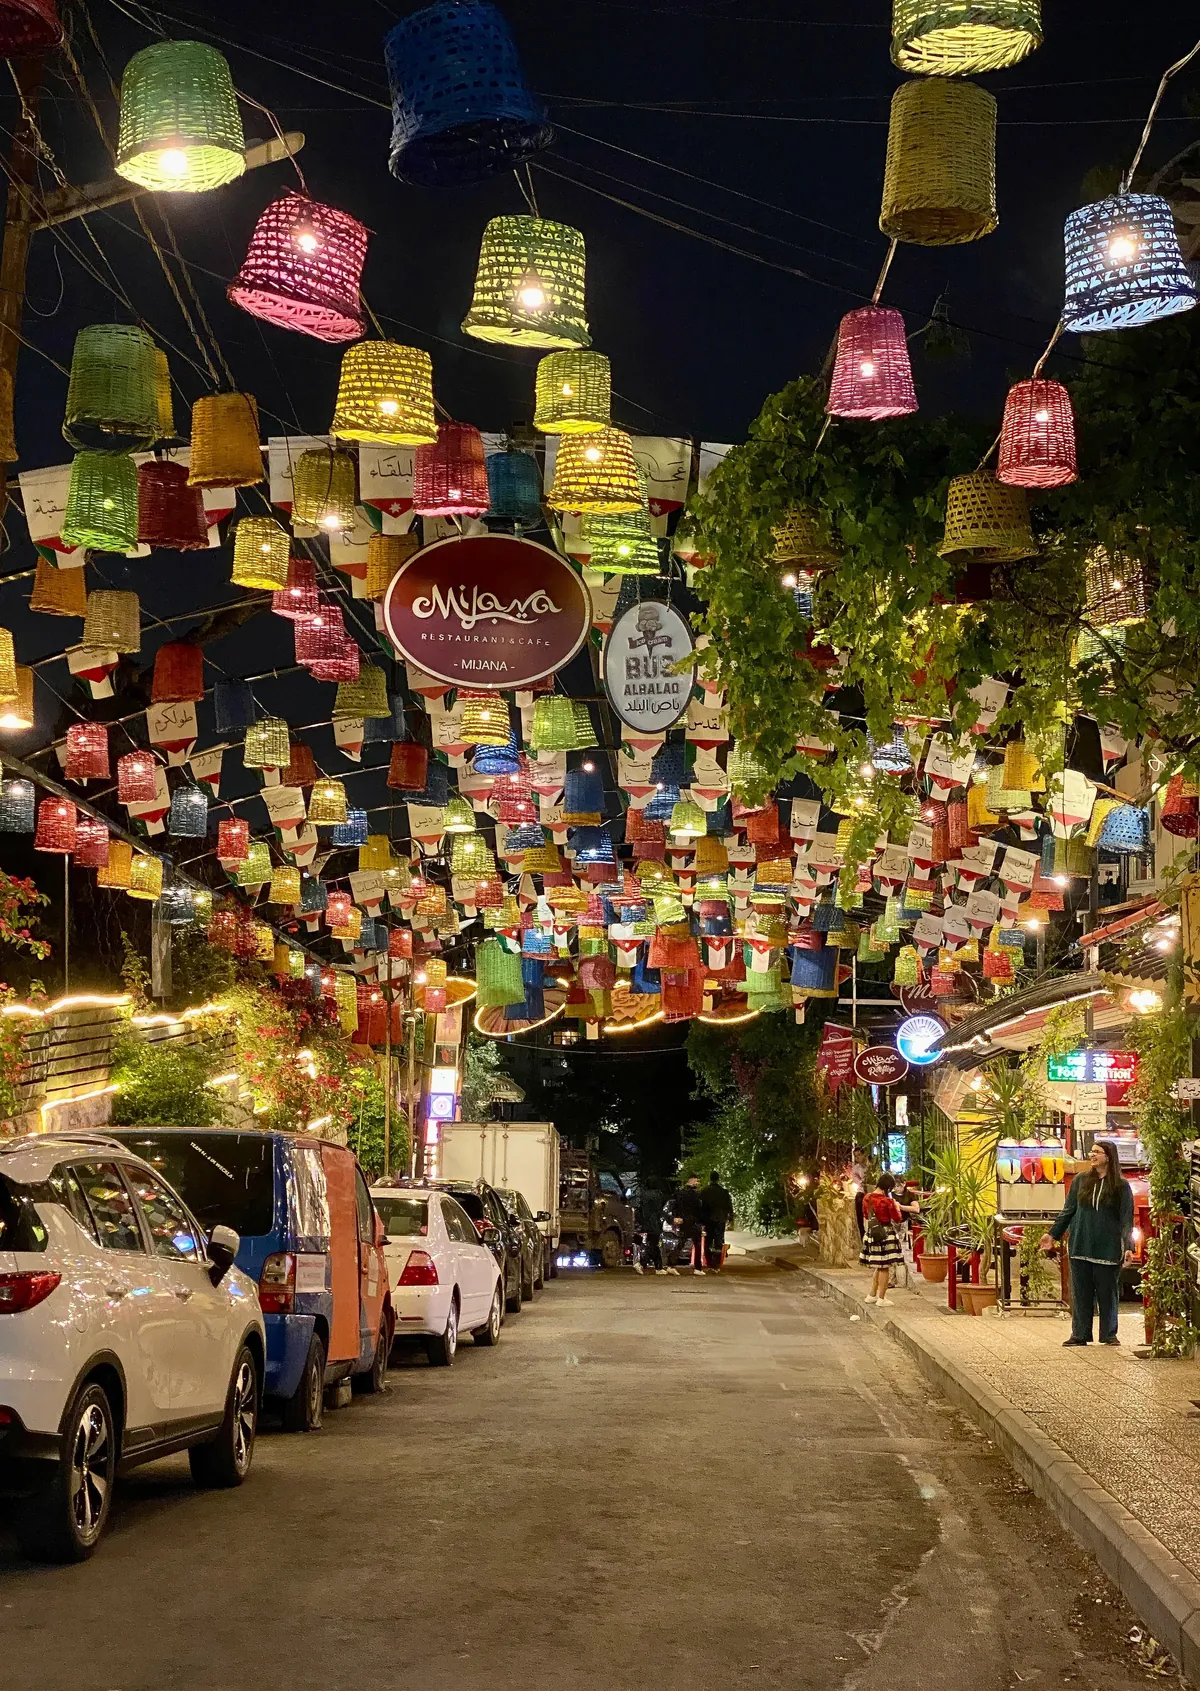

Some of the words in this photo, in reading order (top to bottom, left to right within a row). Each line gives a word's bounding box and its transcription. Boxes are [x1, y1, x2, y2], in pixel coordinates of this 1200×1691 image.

[412, 584, 563, 630] Mijana
[461, 659, 508, 671] MIJANA
[624, 699, 649, 714] البلد
[651, 699, 680, 715] باص
